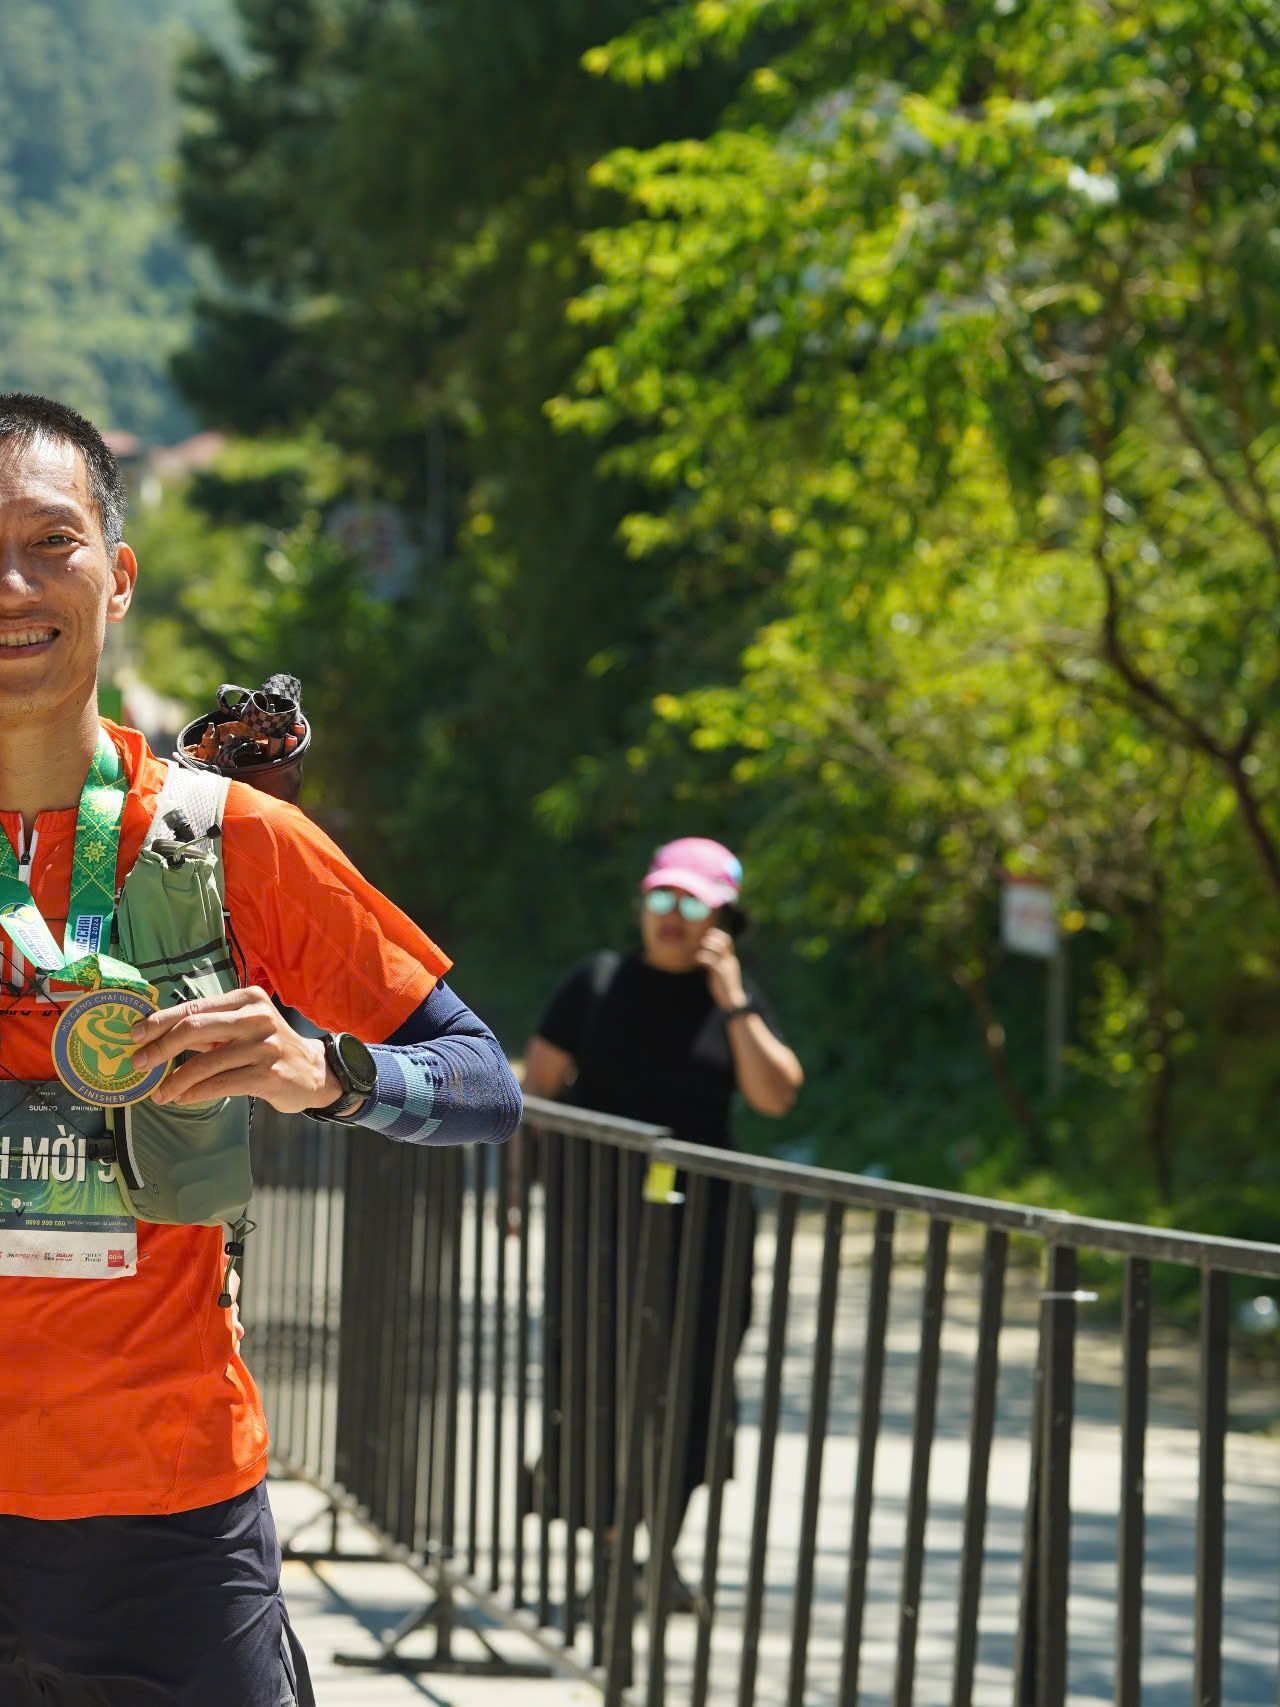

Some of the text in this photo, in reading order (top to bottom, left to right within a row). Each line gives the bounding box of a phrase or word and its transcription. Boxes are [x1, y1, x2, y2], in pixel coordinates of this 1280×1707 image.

[76, 916, 90, 938] CHAI
[92, 918, 100, 935] 2024
[69, 1000, 92, 1018] CANG
[94, 994, 117, 1003] CHAI
[119, 995, 144, 1010] ULTRA
[78, 1085, 126, 1103] FINISHER
[20, 1124, 87, 1182] MỜI
